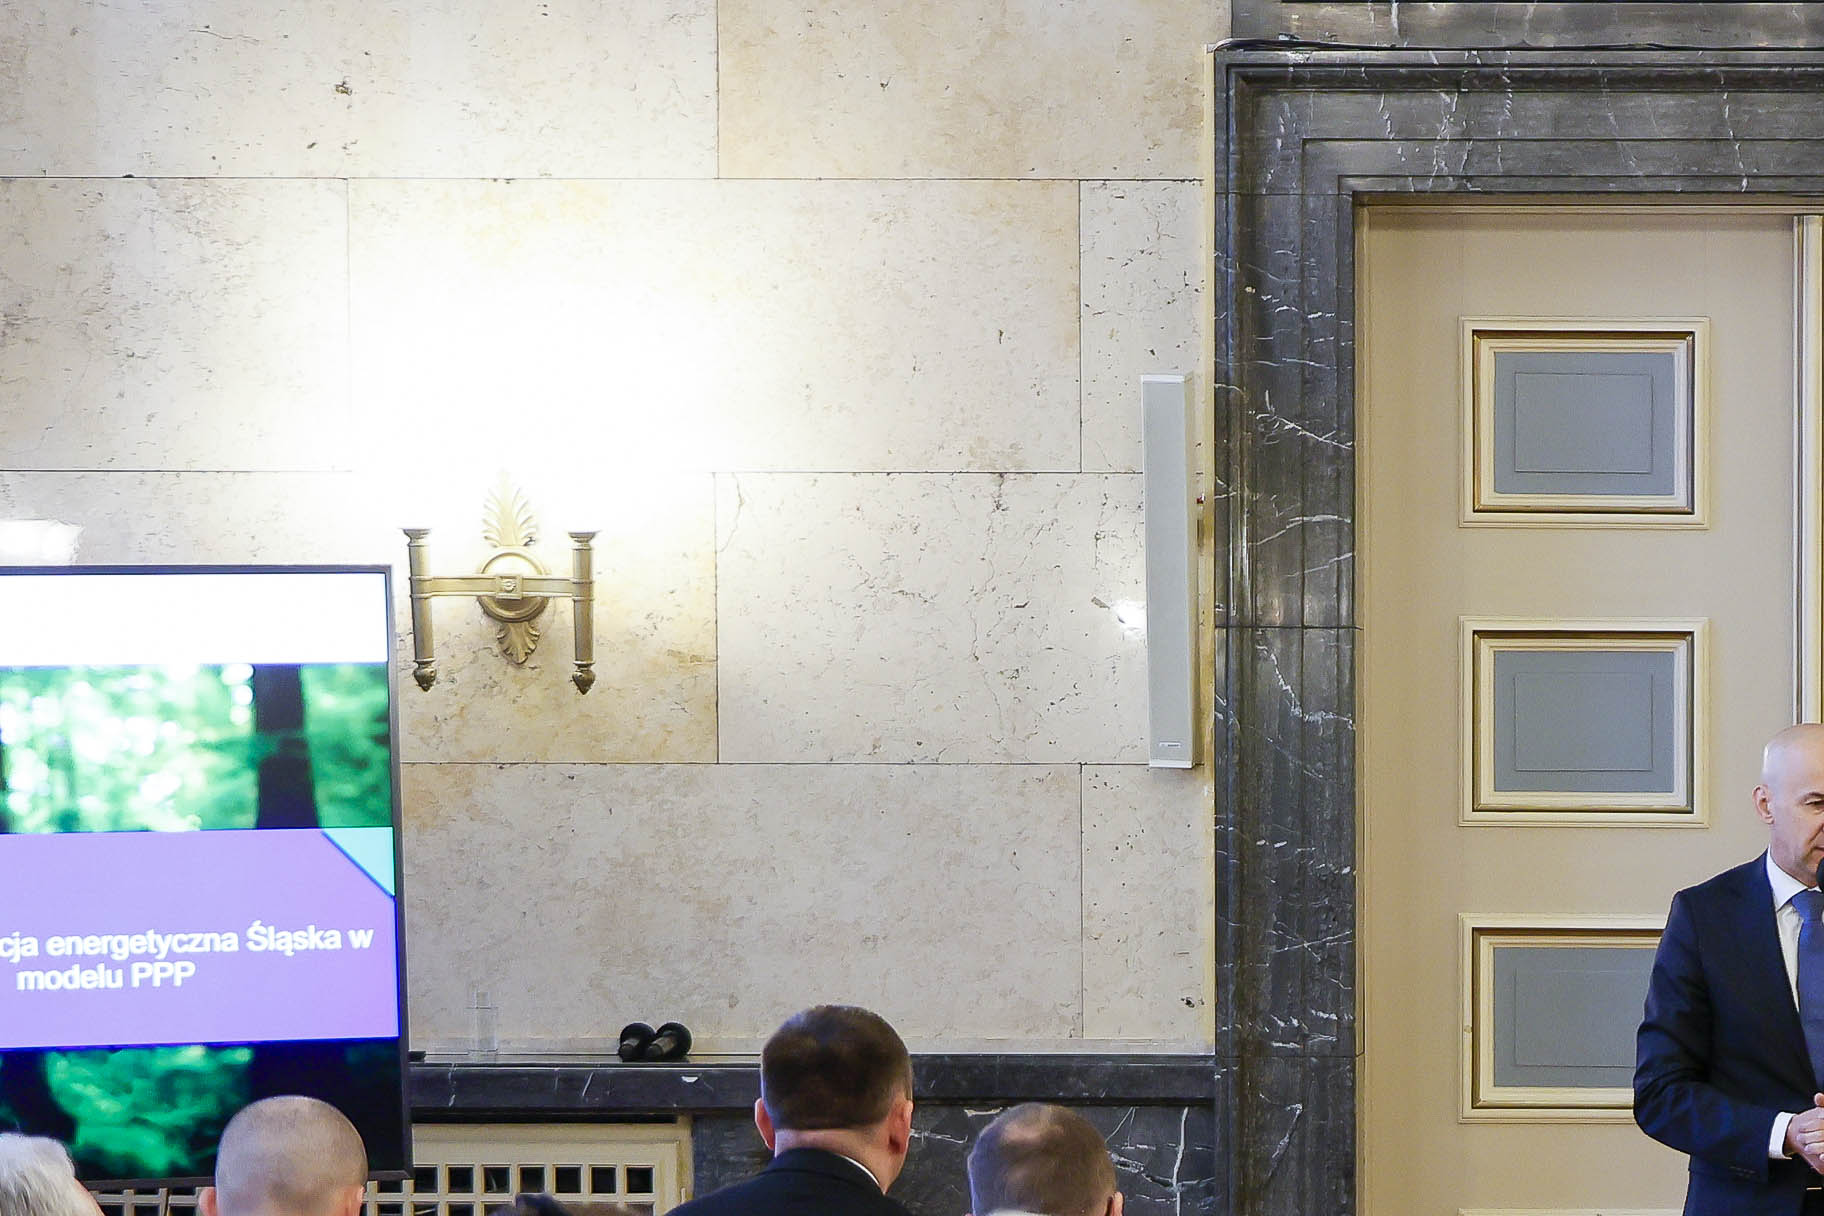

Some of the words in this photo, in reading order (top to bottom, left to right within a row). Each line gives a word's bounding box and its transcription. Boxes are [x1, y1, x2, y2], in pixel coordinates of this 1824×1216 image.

[46, 929, 239, 960] energetyczna
[246, 920, 342, 956] Śląska
[347, 929, 374, 949] w
[16, 963, 123, 990] modelu
[131, 961, 196, 988] PPP
